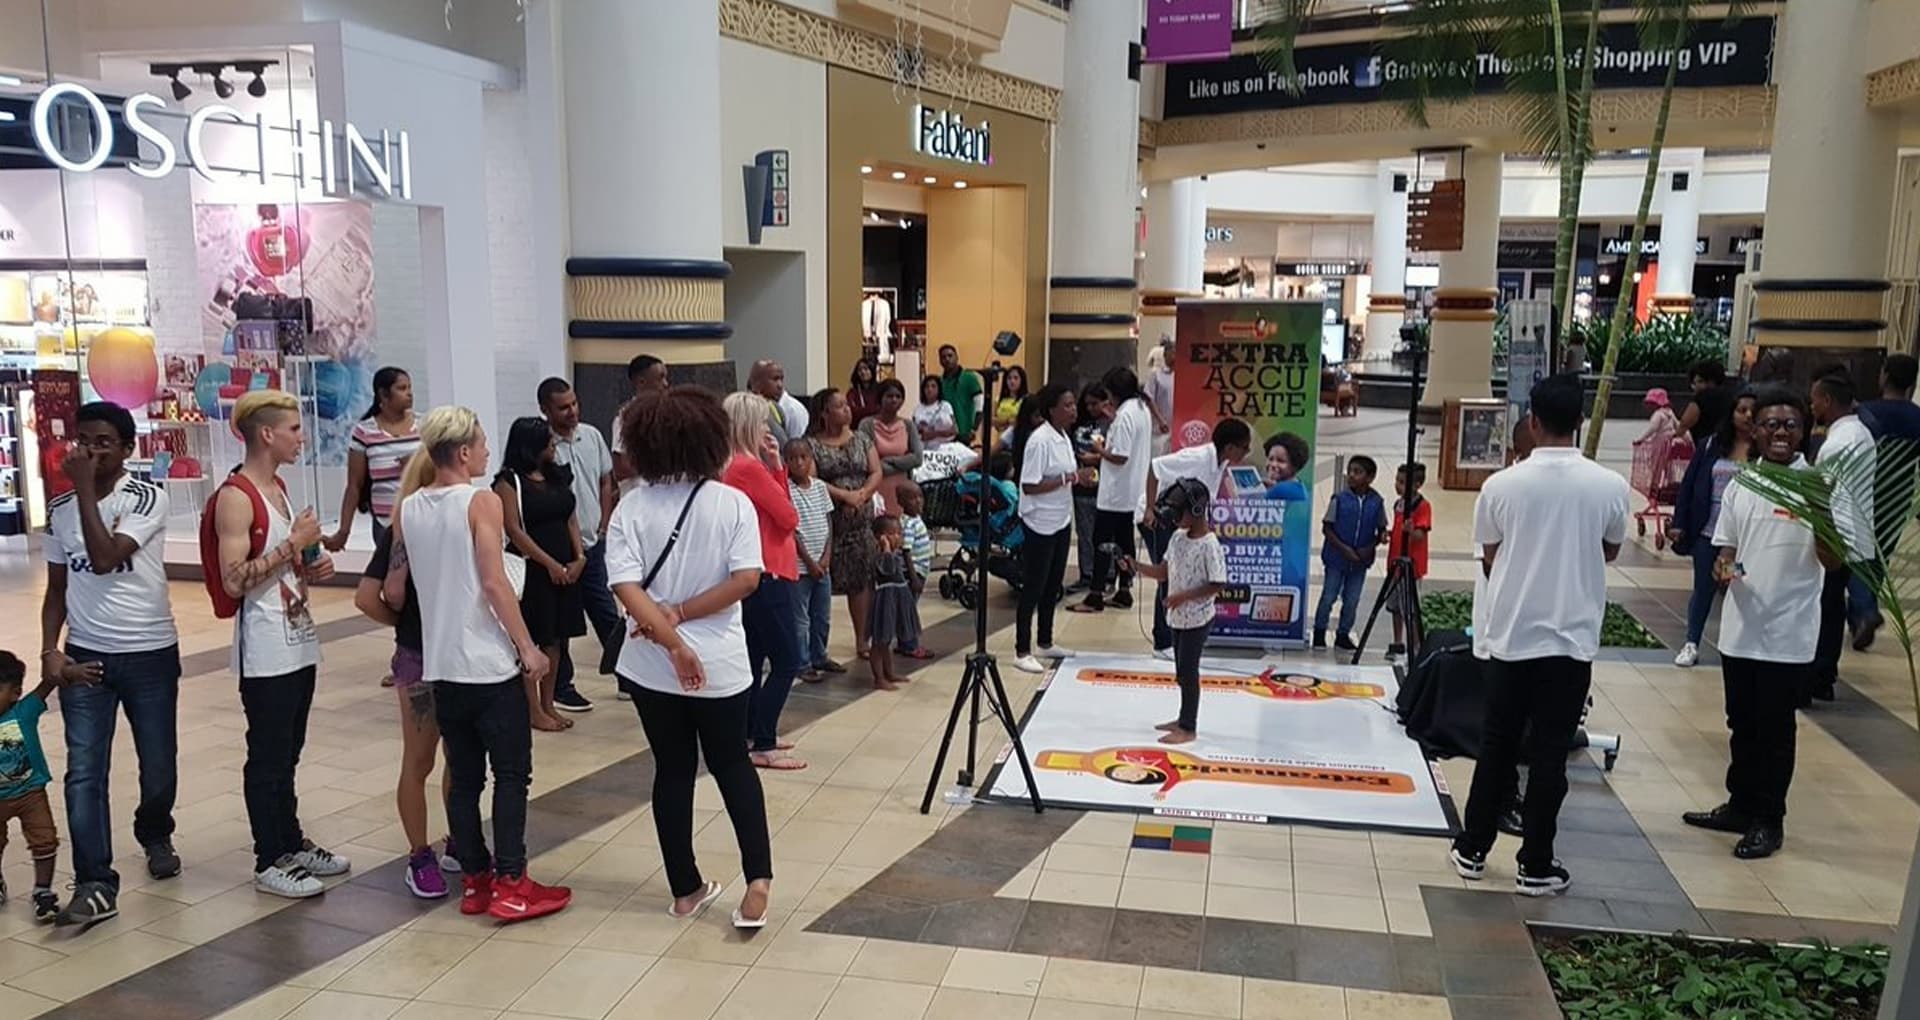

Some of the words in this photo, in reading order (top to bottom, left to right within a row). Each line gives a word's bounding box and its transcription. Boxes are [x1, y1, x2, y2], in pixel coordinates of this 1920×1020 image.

[1189, 79, 1218, 98] Like
[1223, 80, 1240, 95] us
[1244, 78, 1263, 92] on
[1594, 46, 1691, 72] Shopping
[1699, 42, 1737, 65] VIP
[1190, 343, 1309, 362] EXTRA
[1202, 365, 1308, 390] ACCU
[1217, 392, 1306, 417] RATE
[1234, 507, 1285, 523] WIN
[1235, 545, 1268, 556] BUY
[1271, 545, 1282, 556] A
[1228, 573, 1281, 585] CHER!
[1095, 673, 1266, 687] Extraarks
